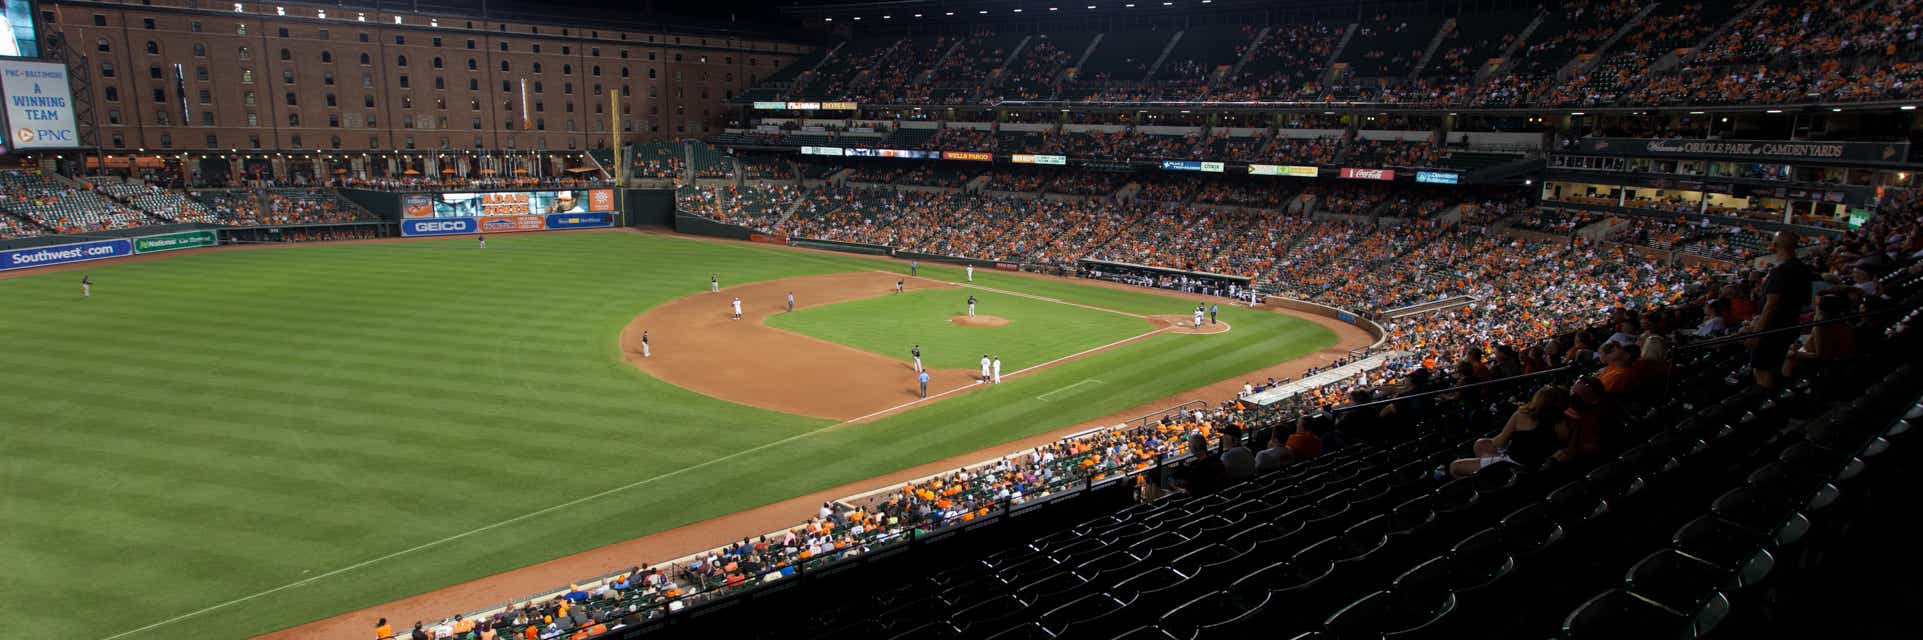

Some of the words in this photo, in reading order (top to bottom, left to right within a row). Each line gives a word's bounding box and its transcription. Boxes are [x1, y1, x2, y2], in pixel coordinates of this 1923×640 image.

[34, 83, 41, 94] A
[13, 95, 65, 107] WINNING
[25, 109, 58, 120] TEAM
[38, 129, 72, 141] PNC
[1684, 142, 1724, 153] ORIOLE
[1724, 143, 1752, 154] PARK
[1762, 143, 1808, 156] CAMDEN
[1808, 144, 1842, 157] YARDS
[481, 193, 528, 204] ADAM
[415, 221, 465, 231] GEICO
